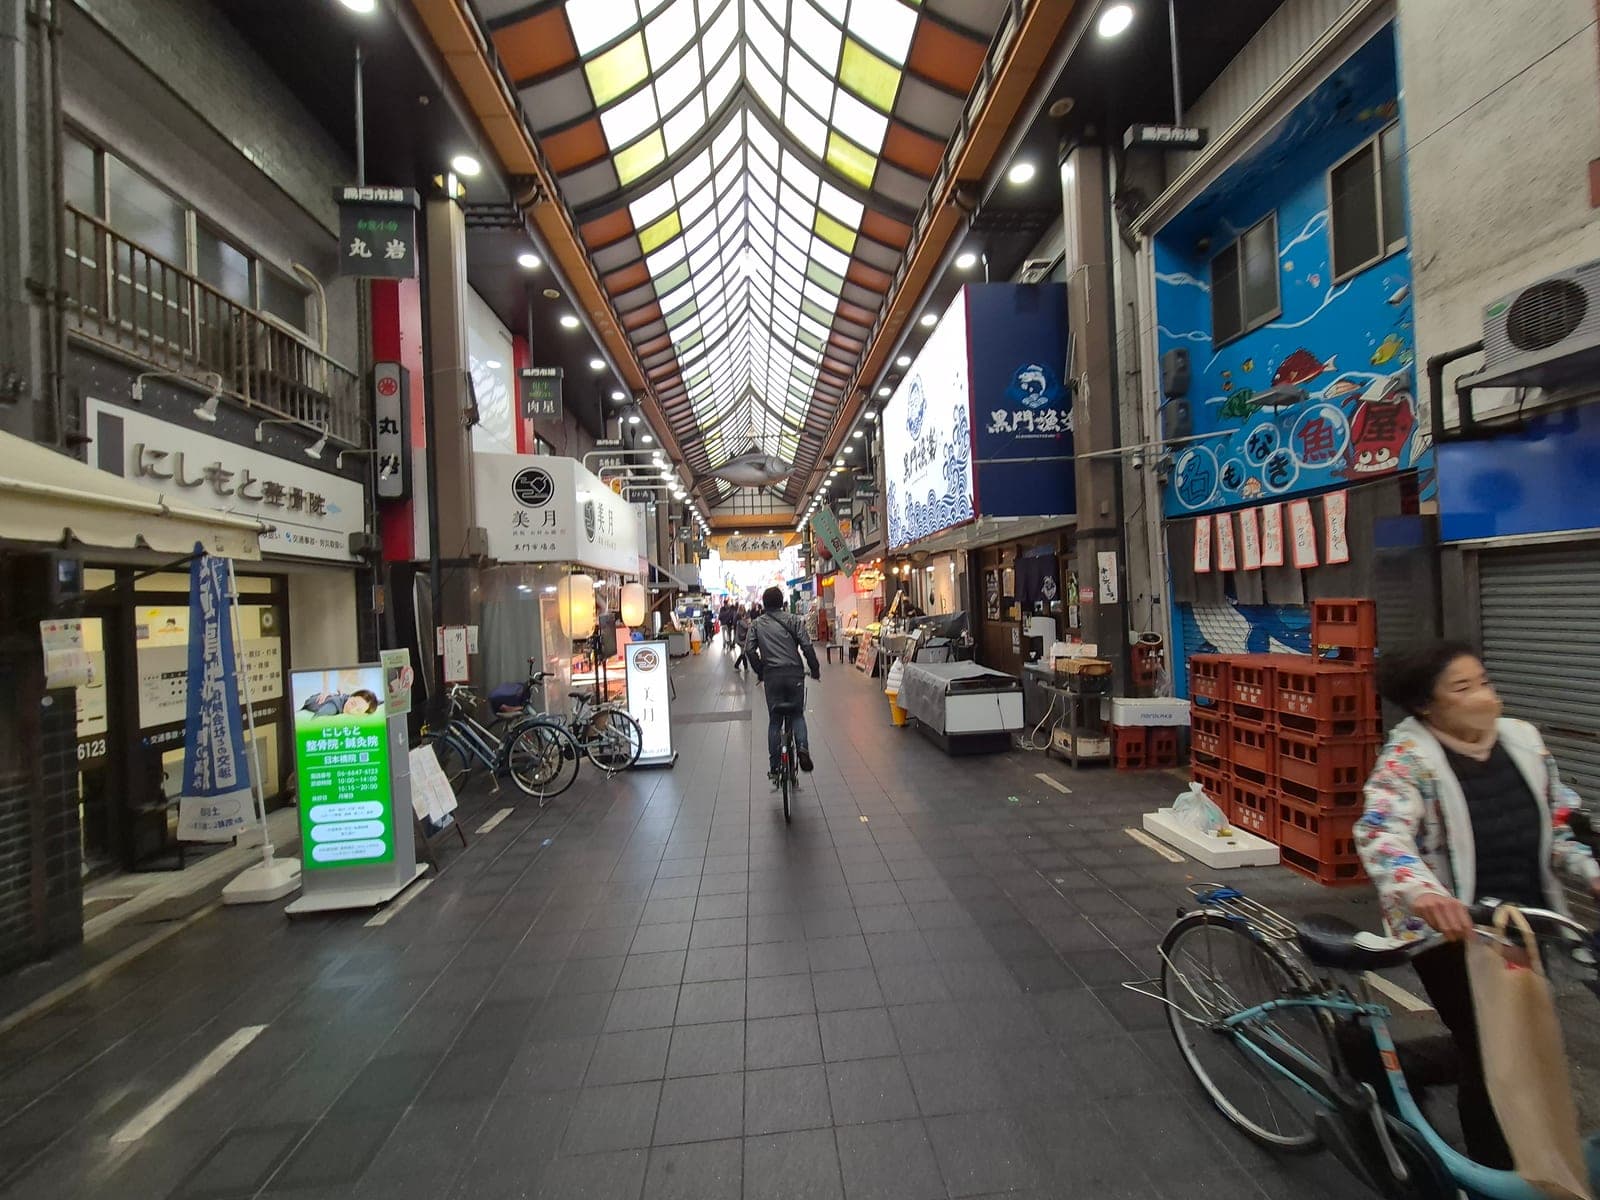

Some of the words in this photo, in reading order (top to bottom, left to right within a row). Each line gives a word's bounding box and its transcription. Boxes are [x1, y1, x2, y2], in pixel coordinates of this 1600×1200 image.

[348, 237, 406, 259] 丸岩
[134, 442, 327, 516] にしもと整骨院
[511, 510, 557, 529] 美月
[322, 725, 361, 738] にしもと
[77, 739, 106, 760] 6123
[305, 734, 379, 753] 整骨院・鍼灸院
